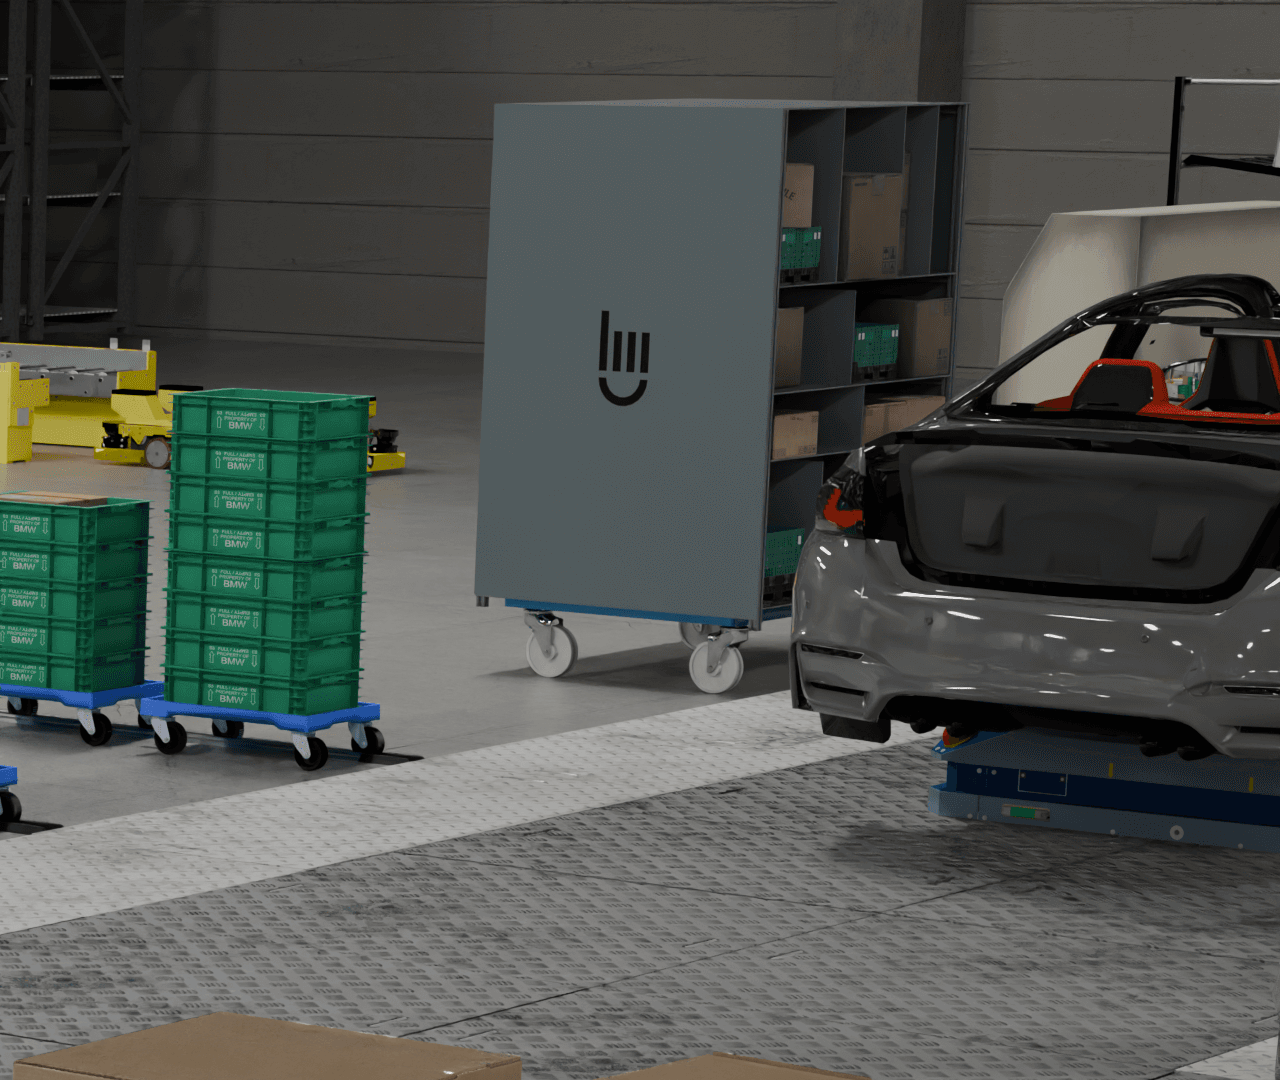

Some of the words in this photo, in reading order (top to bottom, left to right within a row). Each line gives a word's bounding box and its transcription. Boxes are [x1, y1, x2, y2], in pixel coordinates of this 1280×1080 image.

[229, 421, 253, 430] BMW
[227, 462, 251, 470] BMW
[226, 501, 250, 510] BMW
[14, 525, 36, 533] BMW
[225, 540, 249, 548] BMW
[13, 562, 35, 570] BMW
[224, 580, 247, 589] BMW
[12, 599, 34, 608] BMW
[222, 619, 246, 628] BMW
[11, 636, 33, 645] BMW
[221, 657, 245, 666] BMW
[10, 673, 32, 682] BMW
[220, 695, 244, 704] BMW
